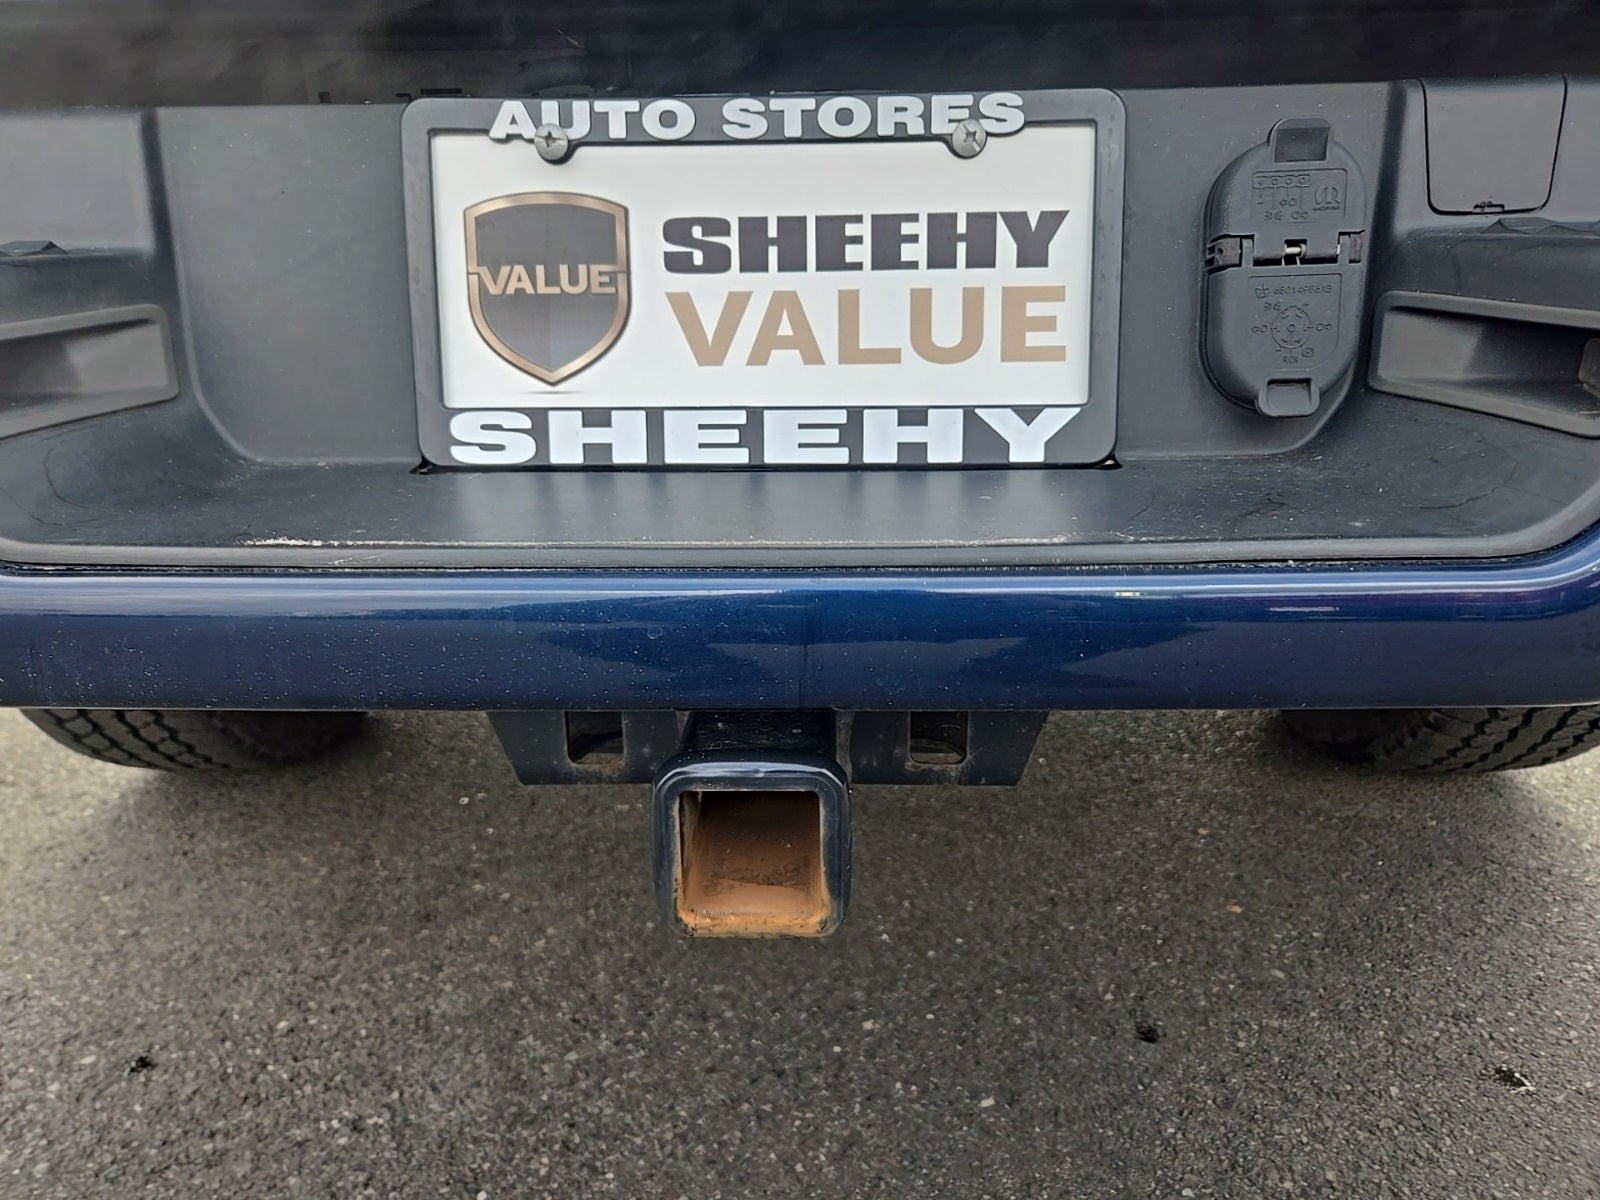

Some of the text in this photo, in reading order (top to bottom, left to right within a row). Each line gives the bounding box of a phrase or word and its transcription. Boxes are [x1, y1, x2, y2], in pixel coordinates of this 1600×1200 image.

[488, 93, 1026, 141] AUTO STORES
[663, 210, 1069, 274] SHEEHY
[478, 264, 617, 295] VALUE
[665, 285, 1067, 367] VALUE
[449, 408, 1081, 466] SHEEHY
